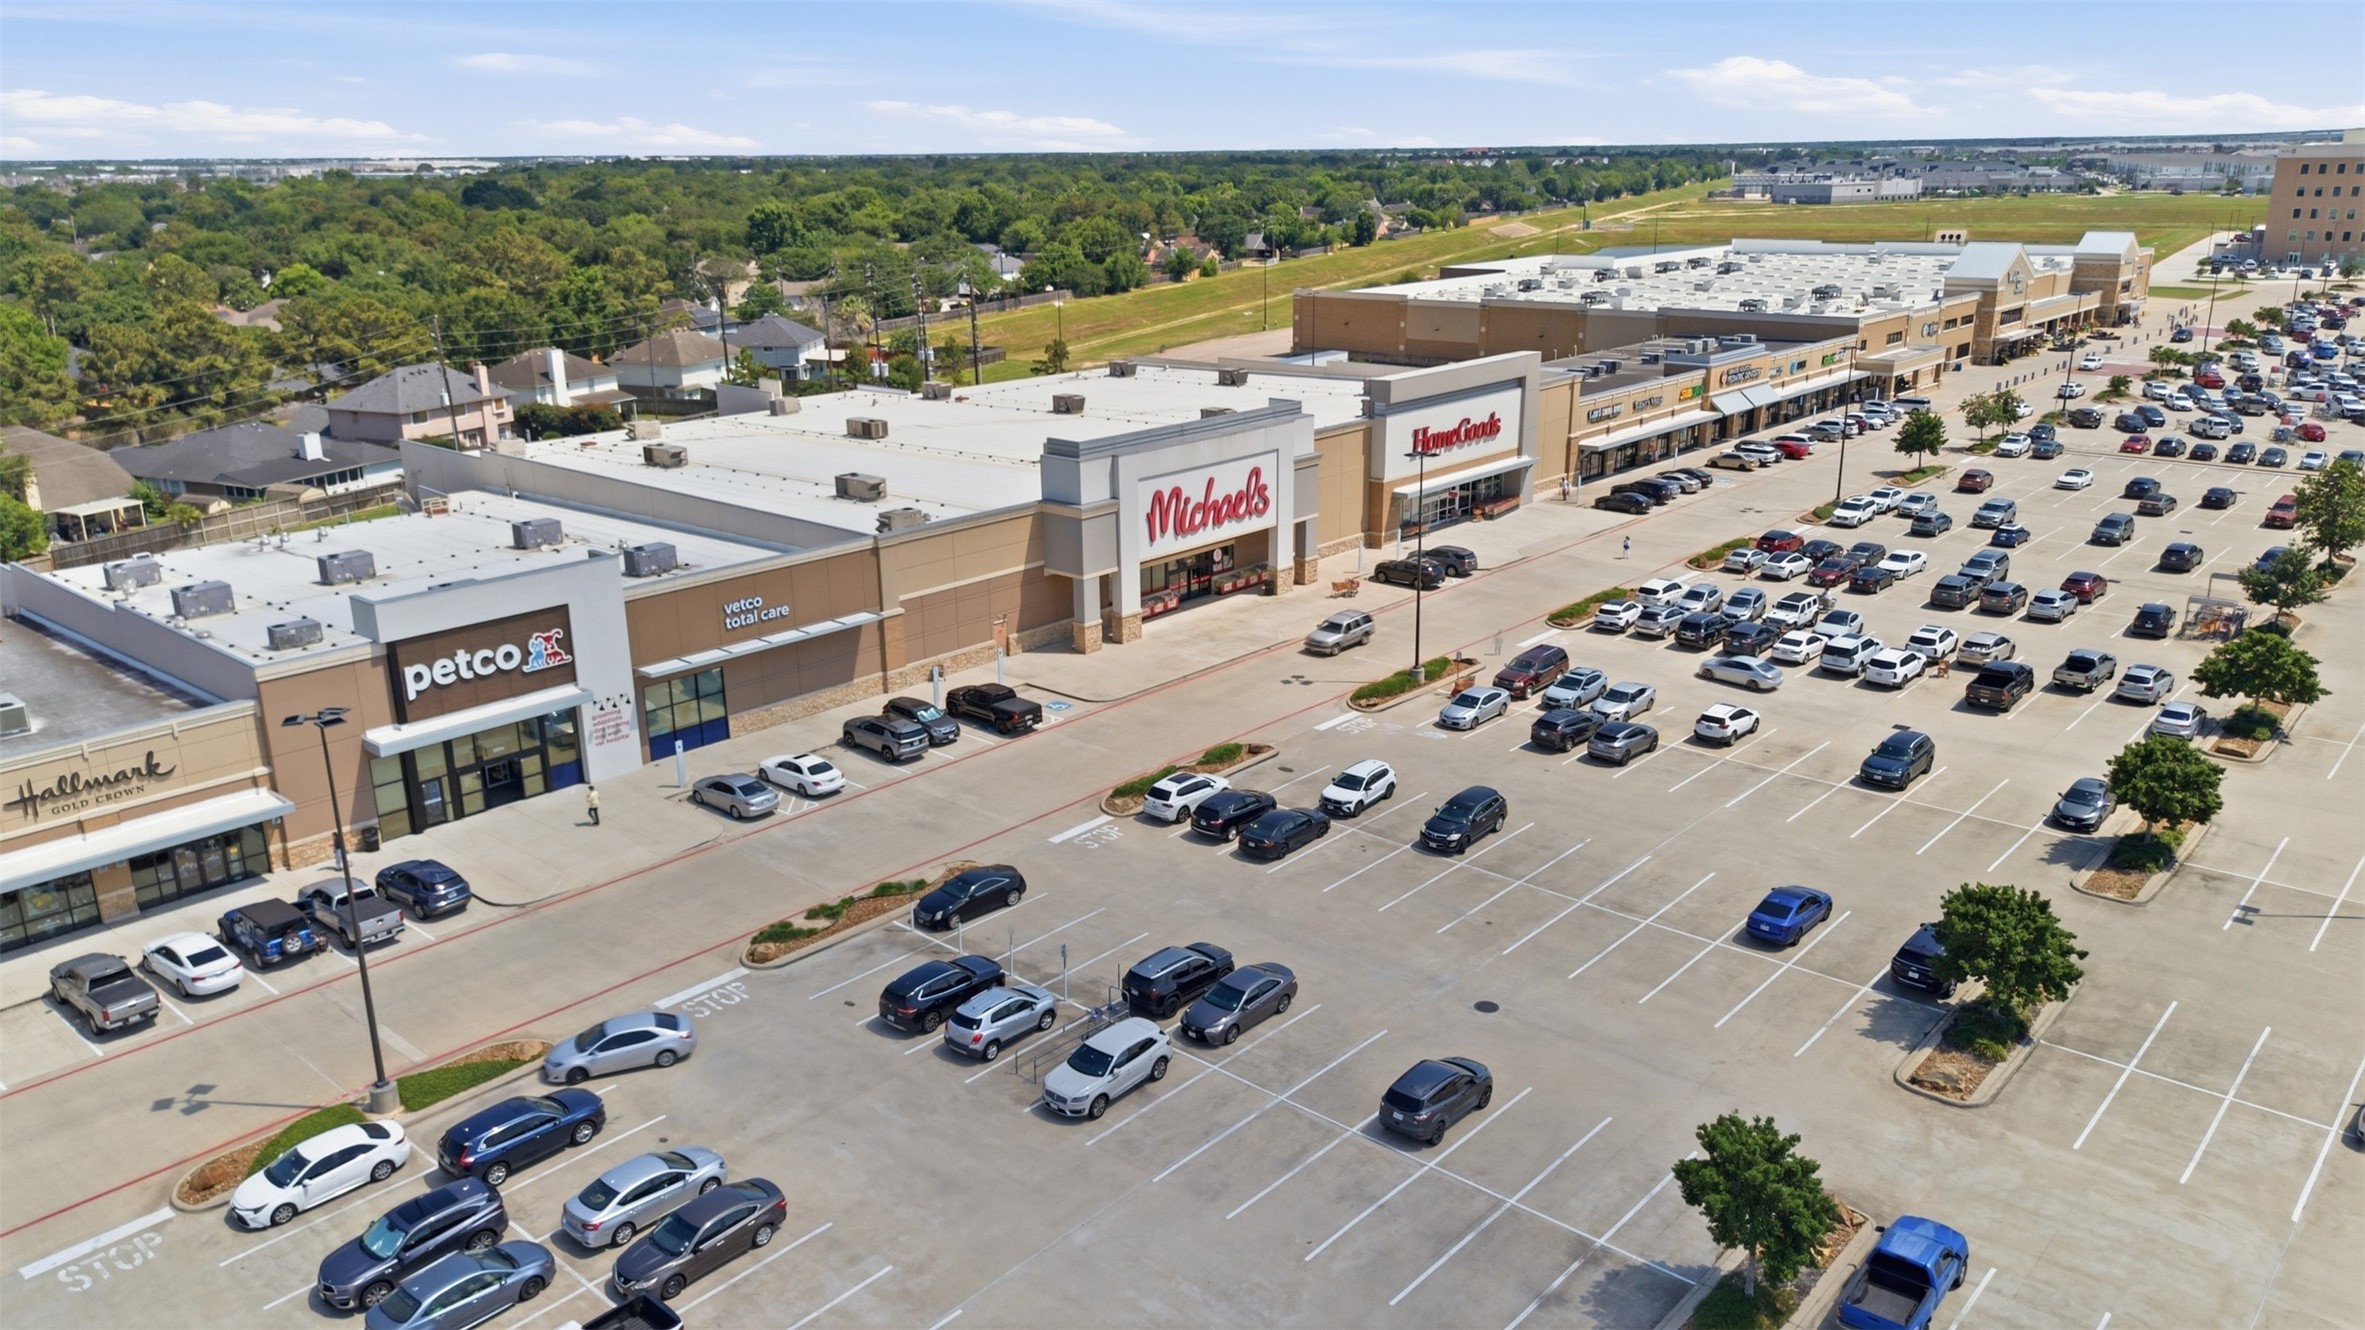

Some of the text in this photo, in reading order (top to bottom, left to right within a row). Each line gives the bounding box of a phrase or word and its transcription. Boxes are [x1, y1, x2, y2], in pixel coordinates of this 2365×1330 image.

[1413, 411, 1501, 453] HomeGoods
[1146, 466, 1270, 542] Michaels
[724, 597, 762, 614] vetco
[725, 605, 789, 629] total care
[404, 643, 522, 701] petco
[3, 750, 177, 819] Hallmark
[51, 784, 145, 816] GOLD CROWN
[1073, 825, 1124, 849] STOP
[681, 982, 750, 1018] STOP
[57, 1231, 163, 1292] STOP
